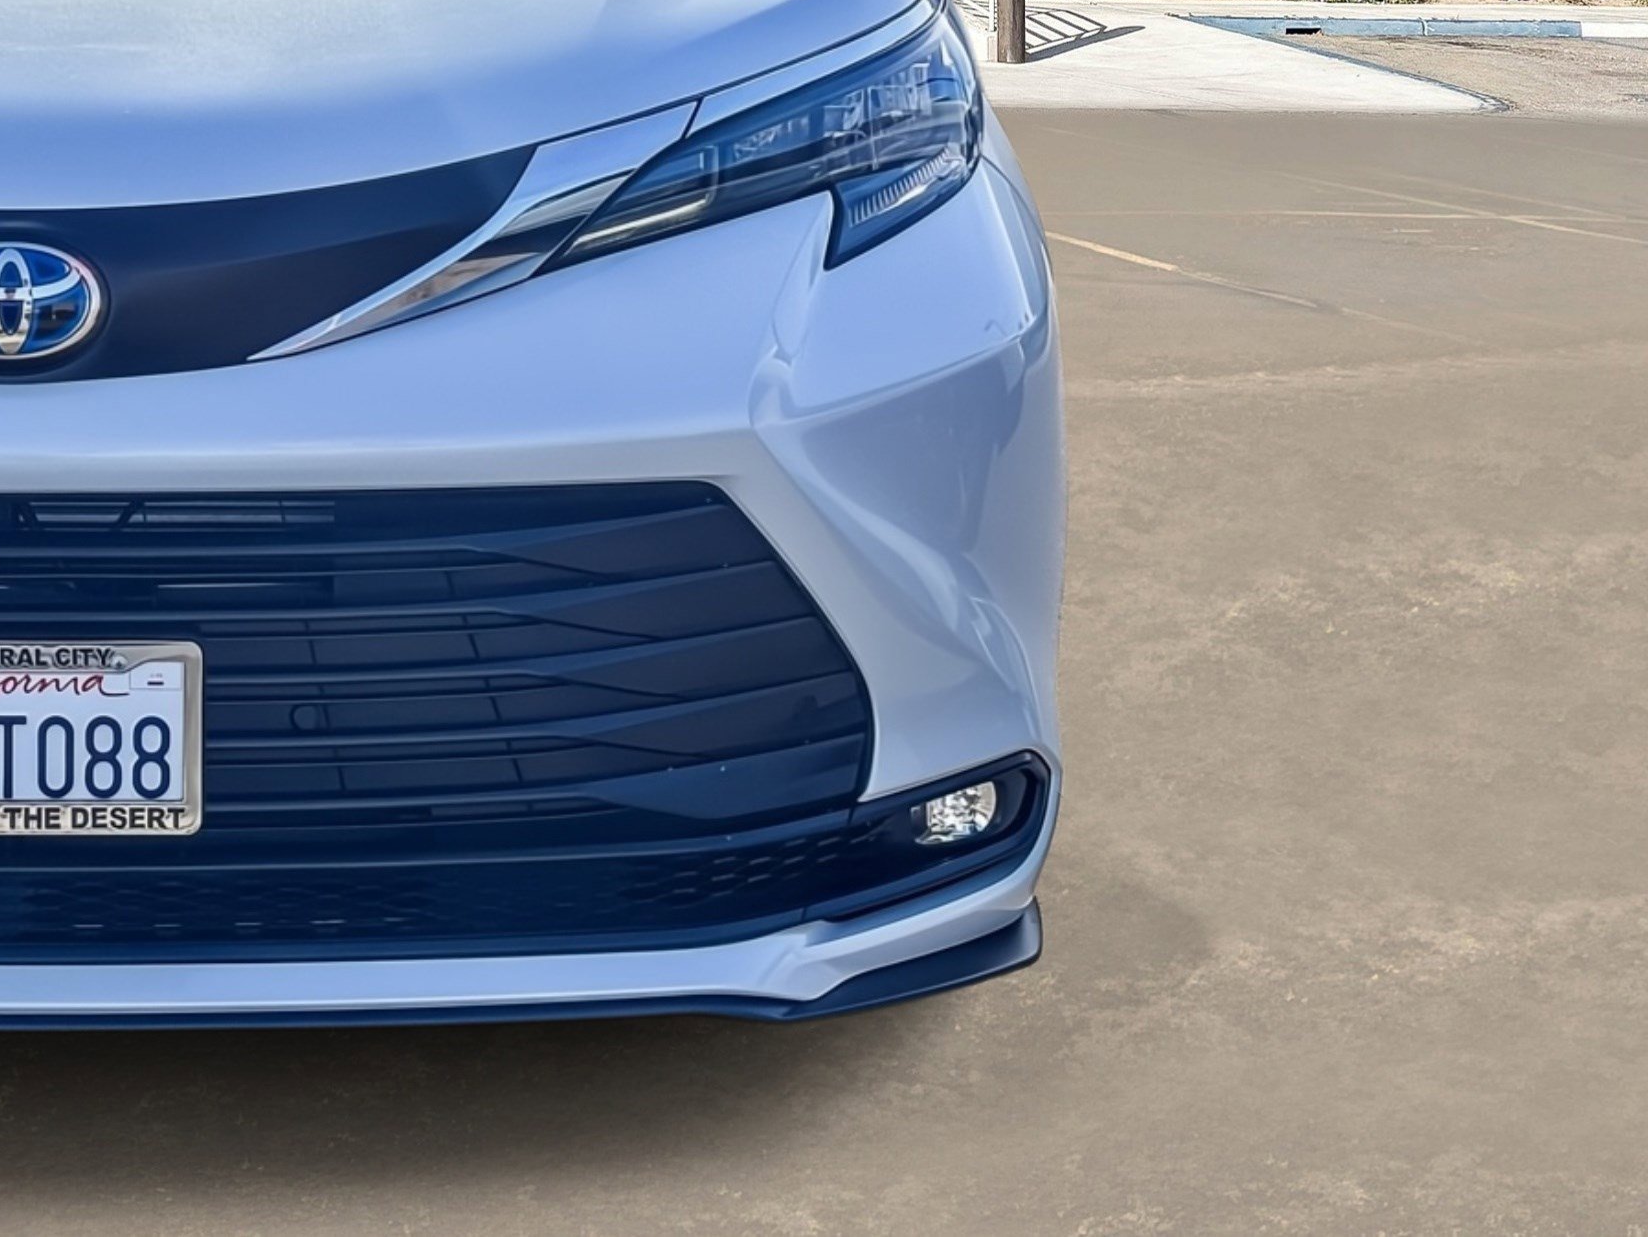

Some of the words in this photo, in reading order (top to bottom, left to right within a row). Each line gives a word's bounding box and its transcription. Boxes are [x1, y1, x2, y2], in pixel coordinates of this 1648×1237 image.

[54, 647, 112, 668] CITY
[4, 807, 61, 831] THE
[70, 807, 185, 831] DESERT
